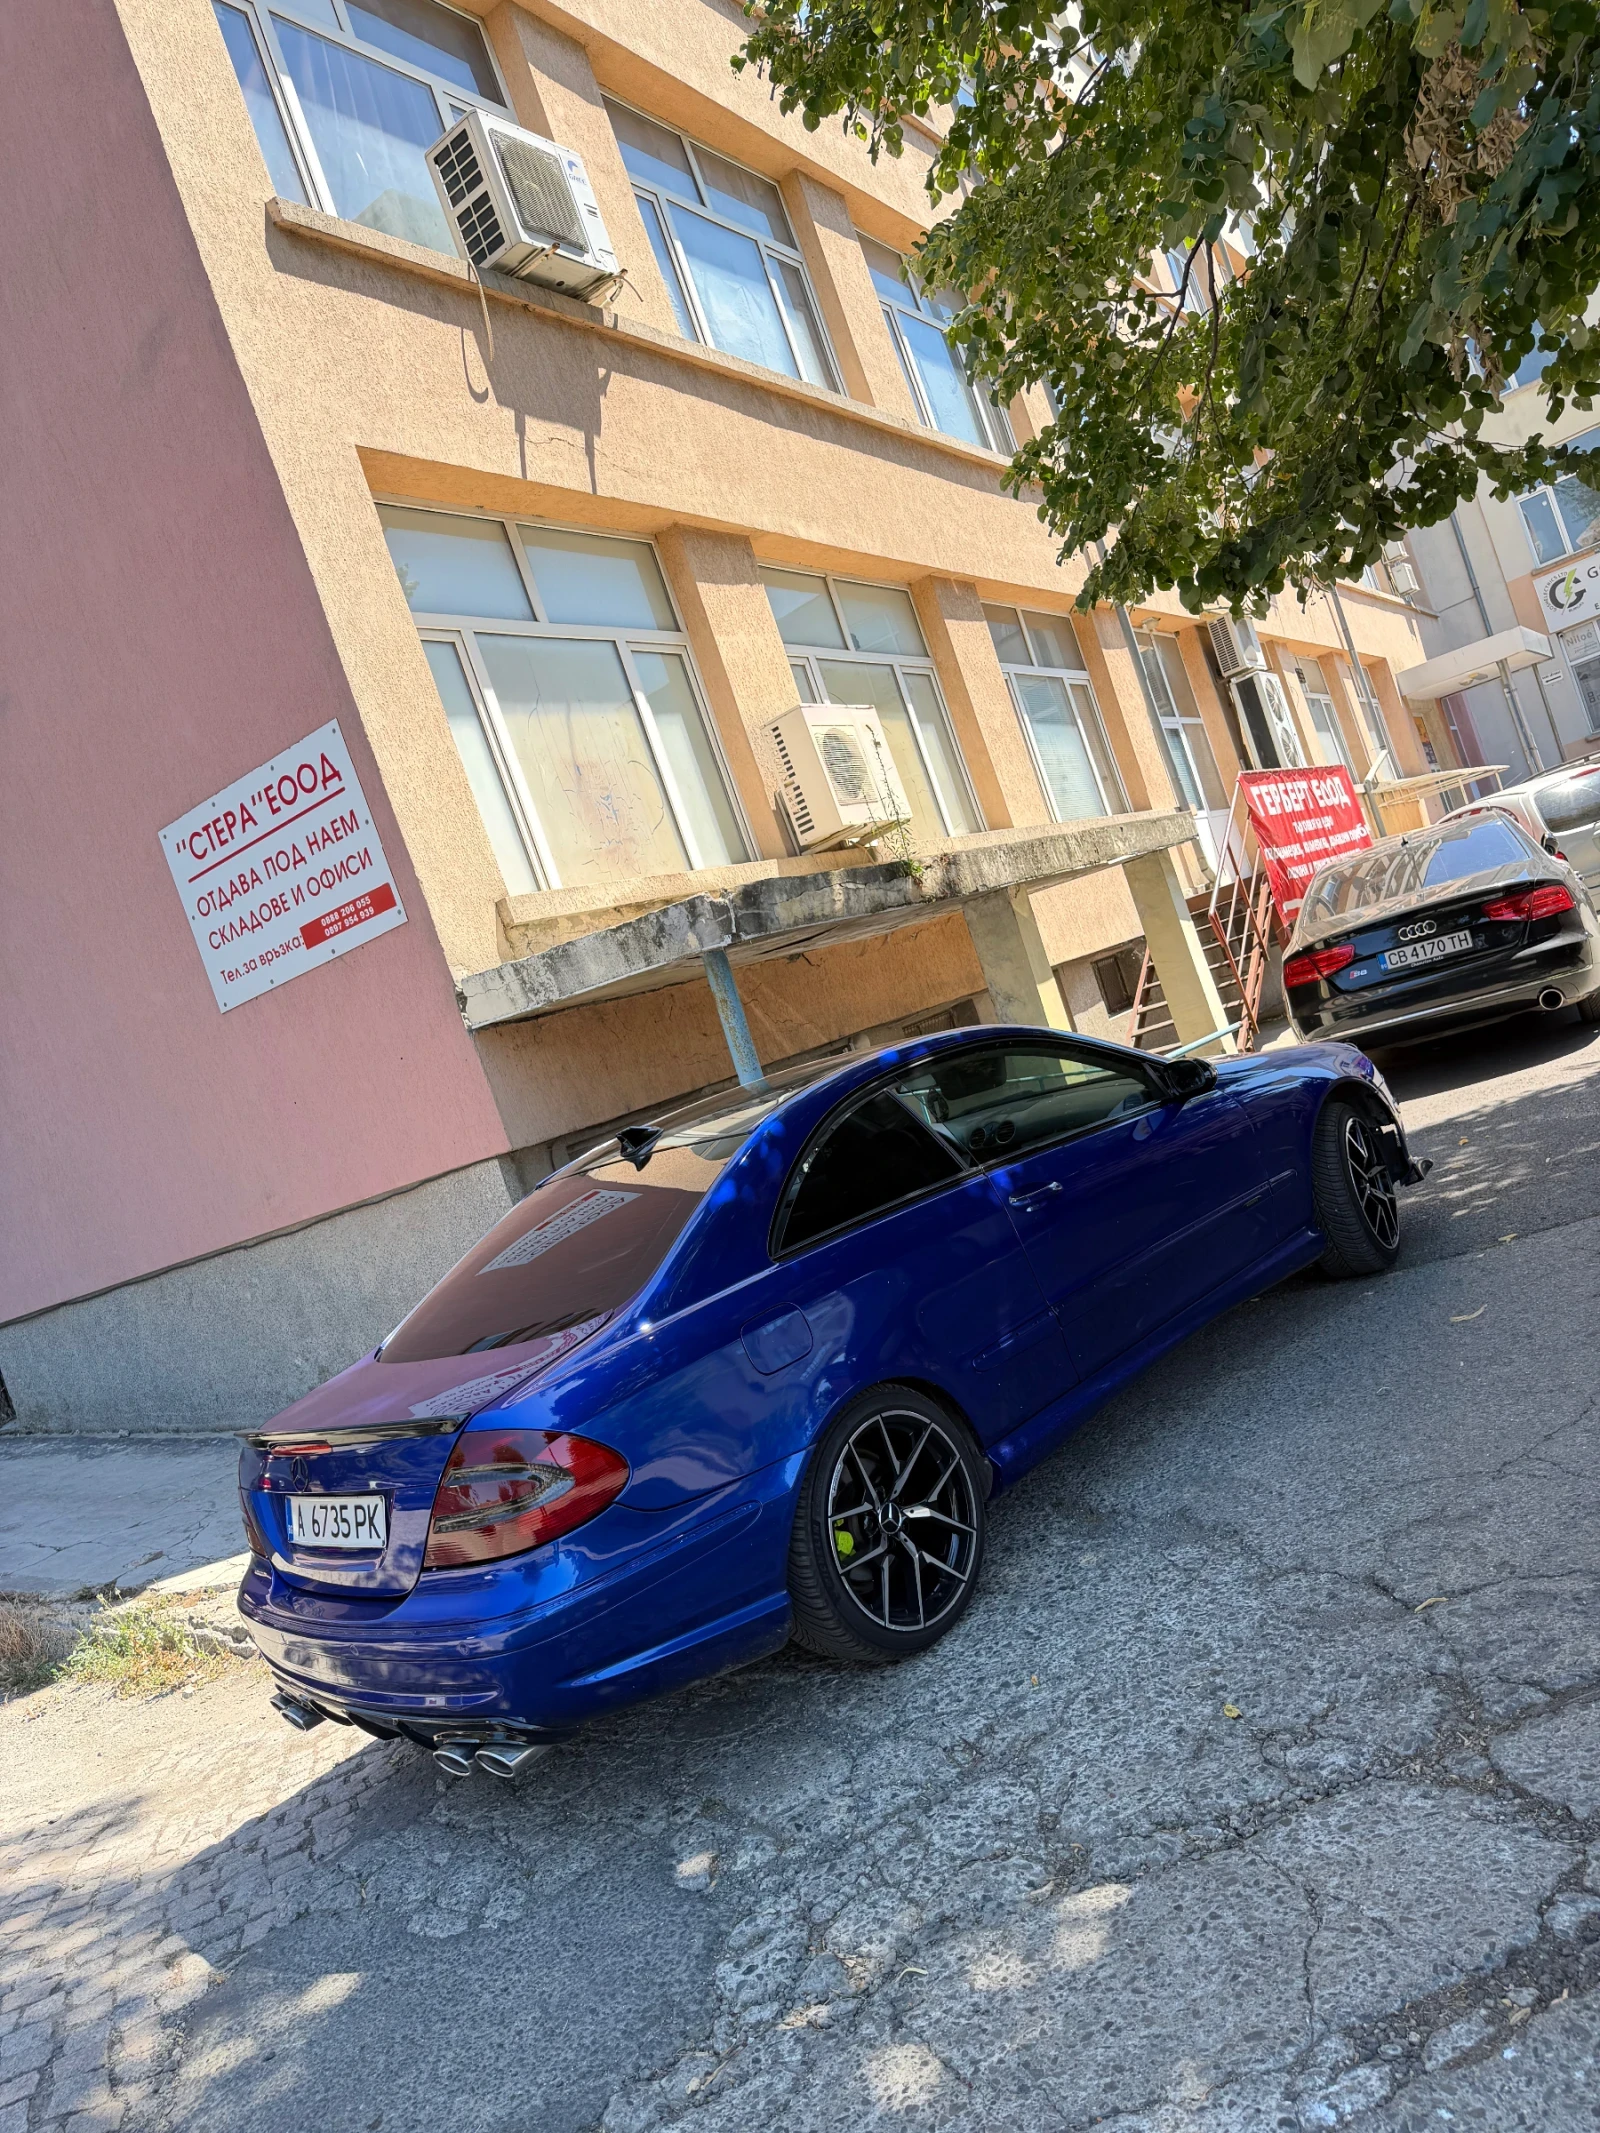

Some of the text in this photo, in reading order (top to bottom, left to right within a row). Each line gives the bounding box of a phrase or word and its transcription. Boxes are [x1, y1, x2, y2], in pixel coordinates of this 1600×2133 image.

[1250, 776, 1351, 817] ГЕРБЕРТ ЕООД
[196, 809, 360, 917] ОТДАВА ПОД НАЕМ
[208, 846, 374, 950] СКЛАДОВЕ И ОФИСИ
[320, 896, 371, 928] 0888 206 055
[324, 906, 375, 937] 0897 954 939
[1388, 932, 1469, 967] CB 4170 TH
[297, 1503, 382, 1539] A 6735 PK
